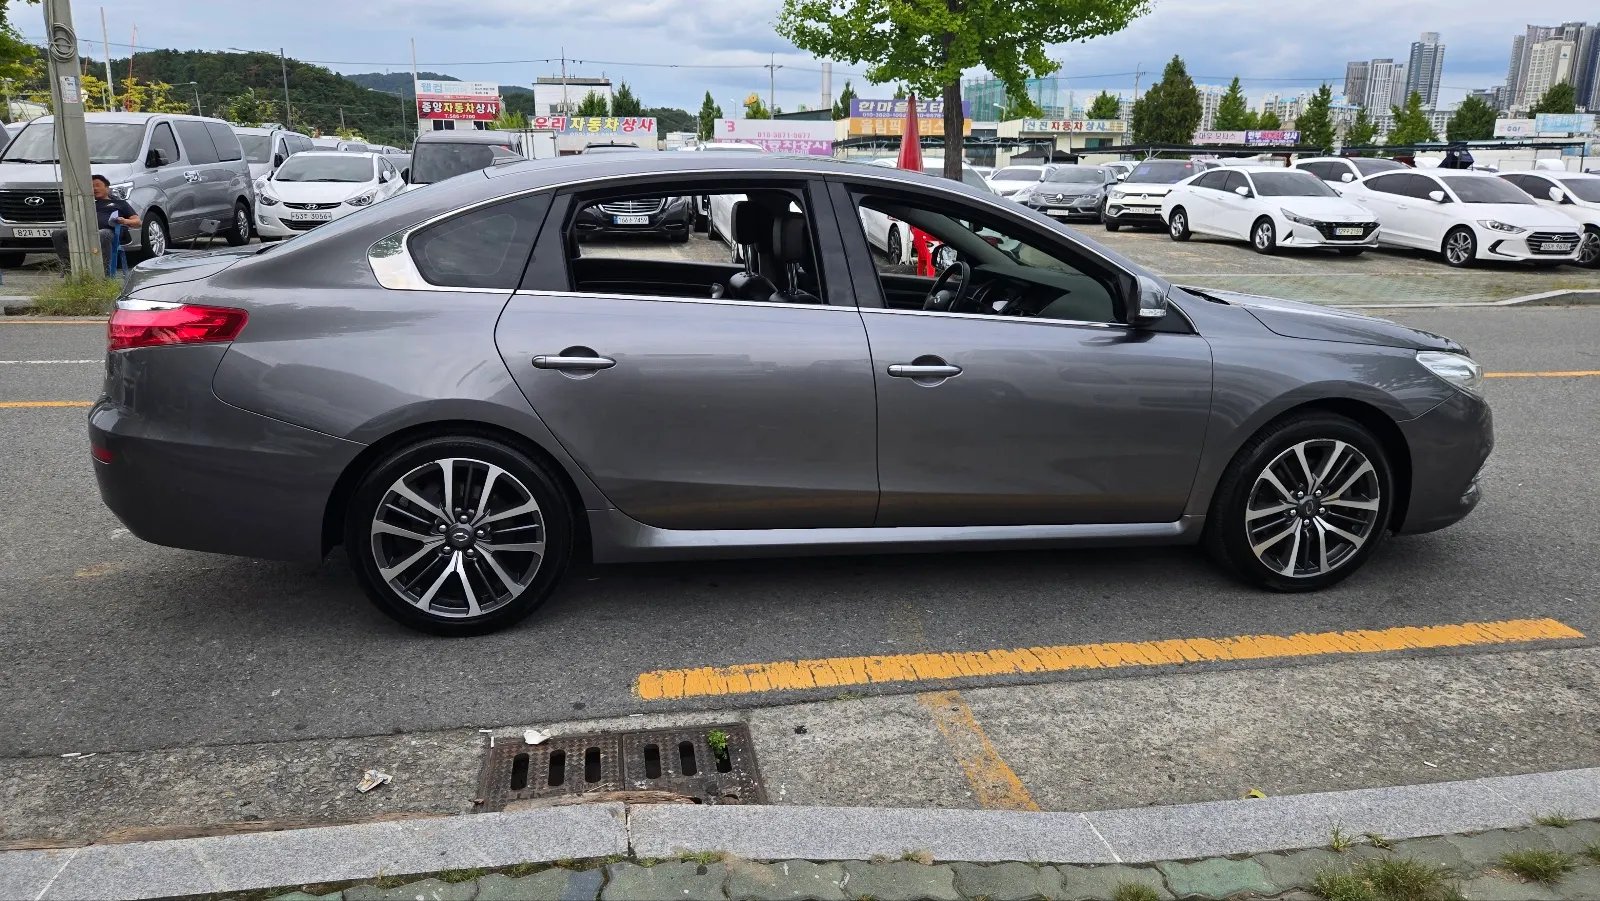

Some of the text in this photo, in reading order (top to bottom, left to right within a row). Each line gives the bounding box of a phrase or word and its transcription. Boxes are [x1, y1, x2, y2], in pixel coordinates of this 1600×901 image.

[421, 102, 497, 114] 중앙자동차상사
[859, 101, 944, 112] 한마음모터
[533, 117, 655, 132] 우리자동차상사
[860, 119, 945, 134] 올림픽터스
